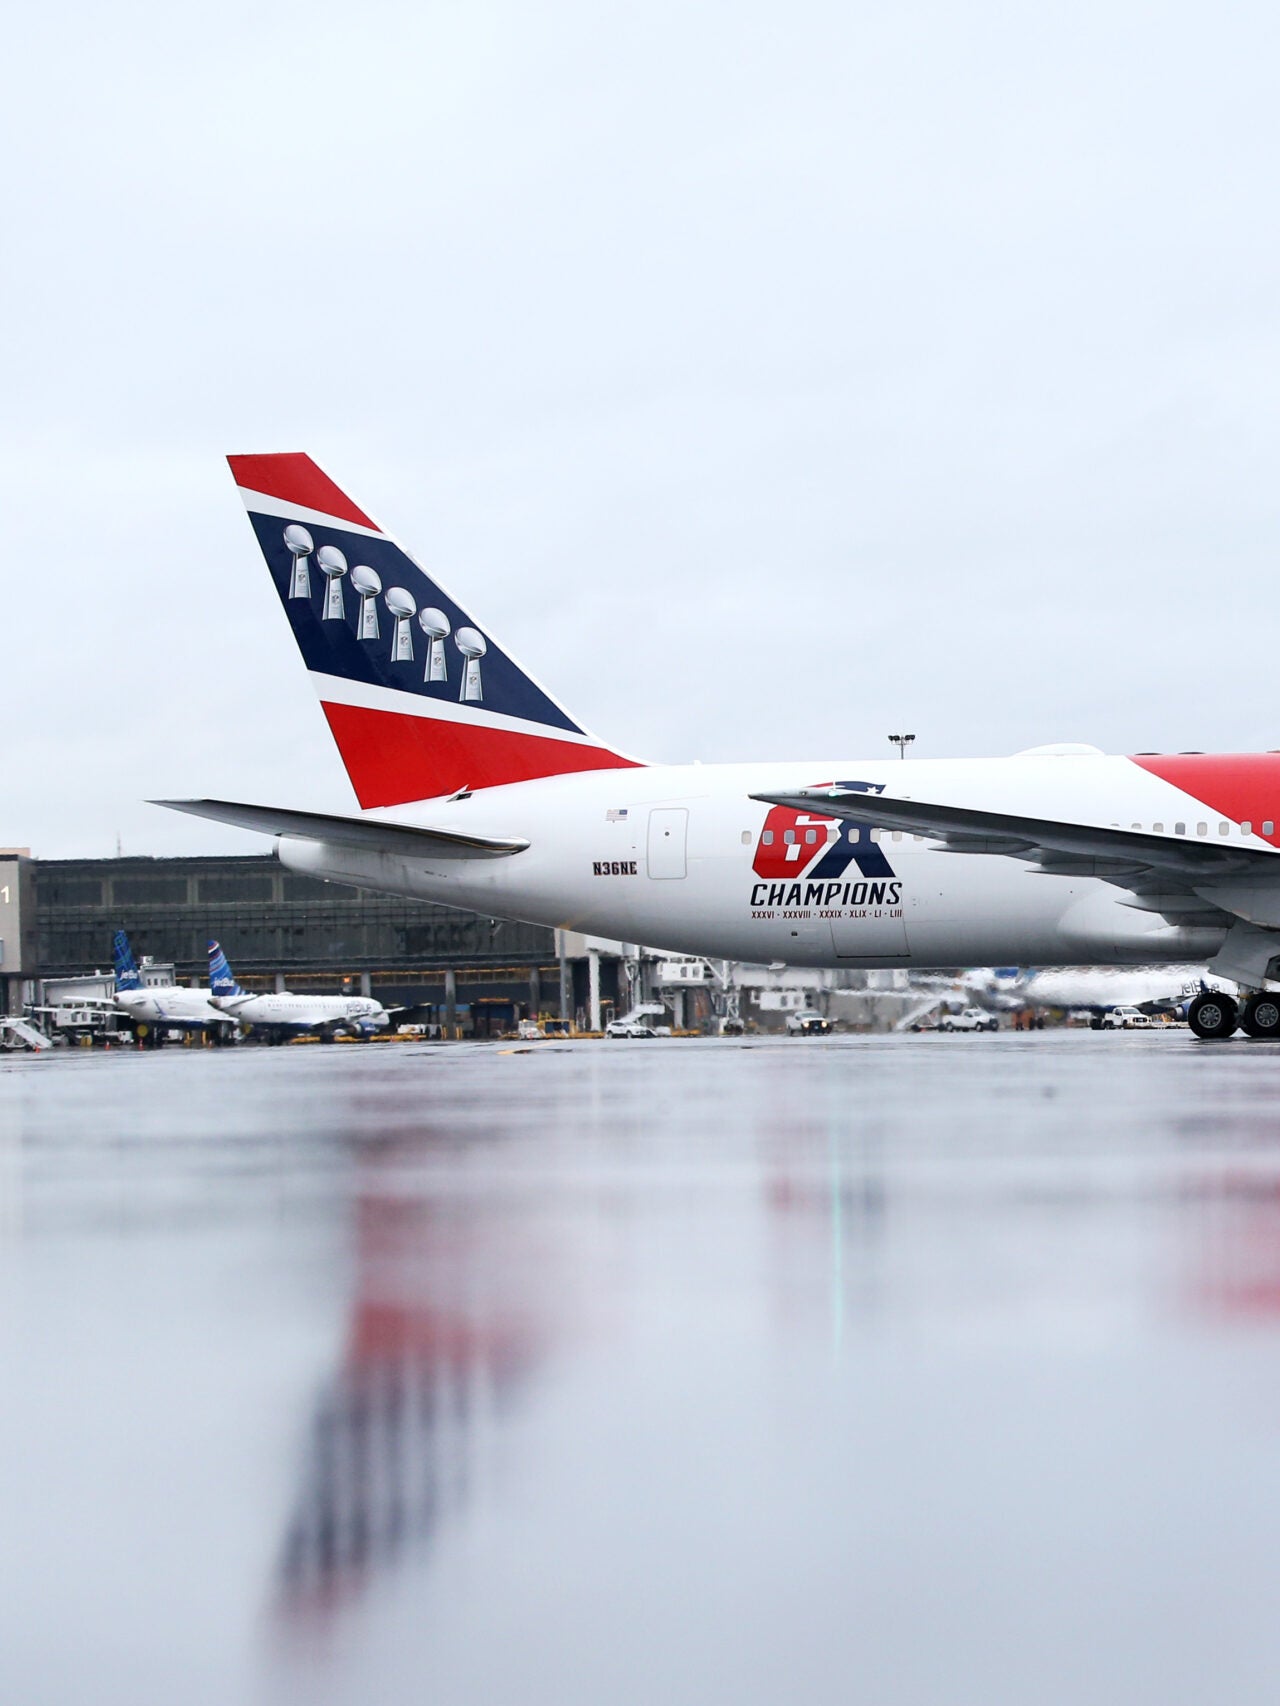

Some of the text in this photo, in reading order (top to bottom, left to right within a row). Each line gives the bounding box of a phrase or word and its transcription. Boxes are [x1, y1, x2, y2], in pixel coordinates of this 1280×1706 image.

[592, 861, 638, 876] N36NE
[0, 885, 10, 904] 1
[750, 882, 903, 906] CHAMPIONS
[751, 909, 903, 919] XXXVI XXXVIII XXXIX XLIX LI LIII
